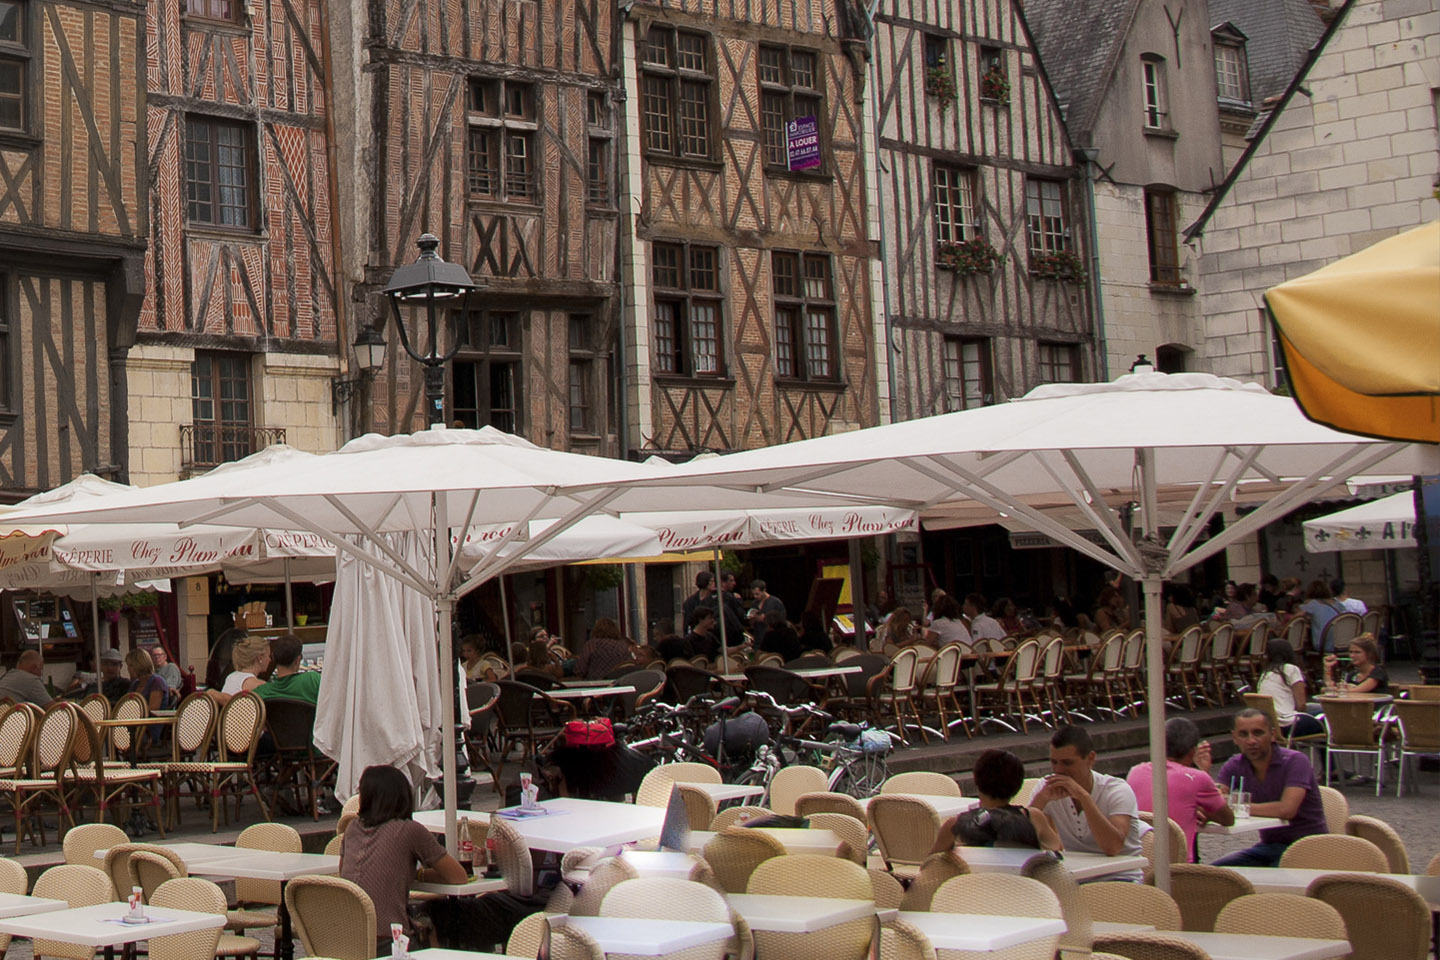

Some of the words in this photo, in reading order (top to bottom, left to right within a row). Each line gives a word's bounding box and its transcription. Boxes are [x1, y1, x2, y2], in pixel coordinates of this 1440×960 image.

[789, 140, 795, 149] A
[795, 136, 817, 147] LOUER
[809, 514, 834, 535] Chez
[1383, 522, 1394, 539] A
[130, 540, 162, 565] Chez
[195, 581, 202, 591] 8
